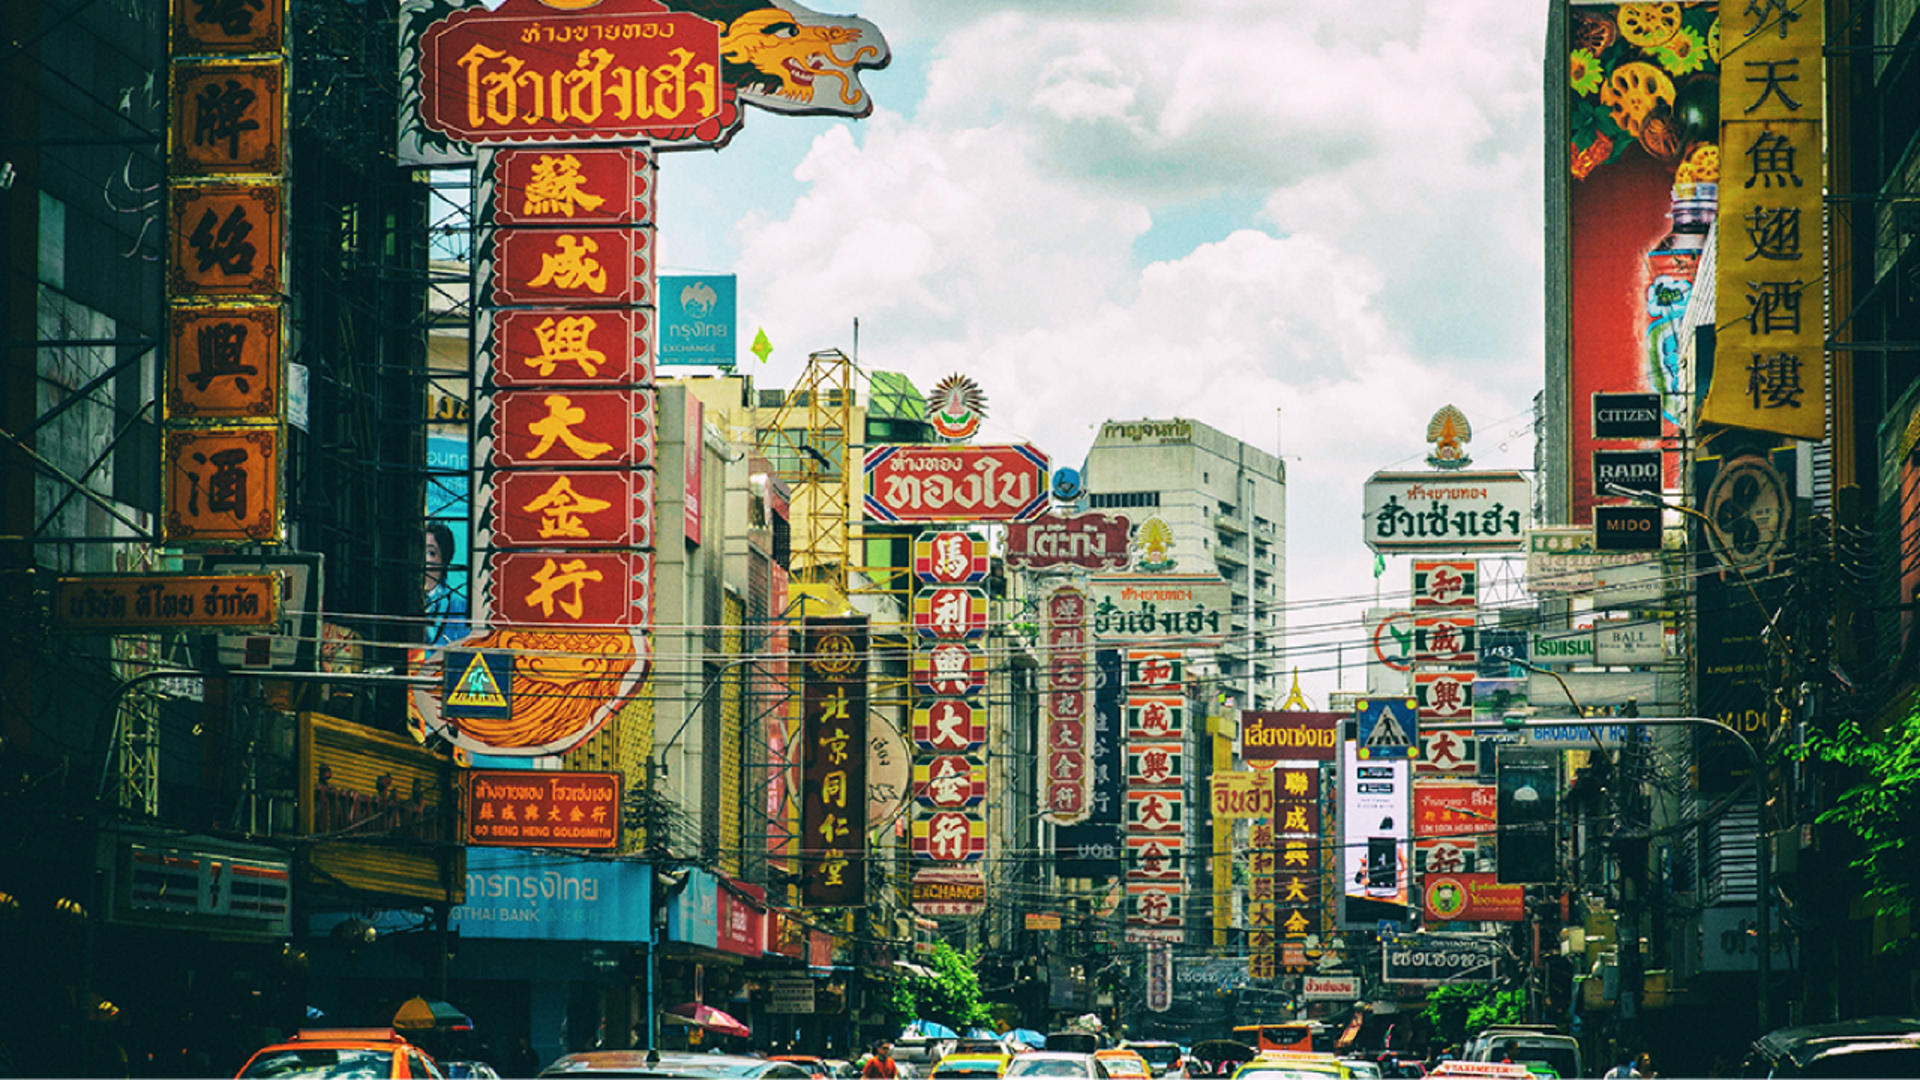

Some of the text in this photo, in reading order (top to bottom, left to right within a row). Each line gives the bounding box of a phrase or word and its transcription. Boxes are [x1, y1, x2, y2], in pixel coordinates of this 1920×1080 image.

[521, 22, 674, 43] ห้างขายทอง
[669, 321, 728, 341] กรุงไทย
[522, 154, 613, 620] 蘇成興大金行
[1598, 409, 1657, 423] CITIZEN
[890, 451, 963, 472] ห้างทอง
[1600, 464, 1659, 478] RADO
[1407, 484, 1487, 500] ห้างขายทอง
[1606, 519, 1652, 532] MIDO
[1612, 631, 1648, 642] BALL
[818, 686, 851, 886] 北京同仁堂
[474, 825, 612, 839] SO SENG HENG GOLDSMITH
[1077, 843, 1115, 858] UOB
[912, 884, 984, 900] EXCHANGE
[500, 907, 540, 922] BANK
